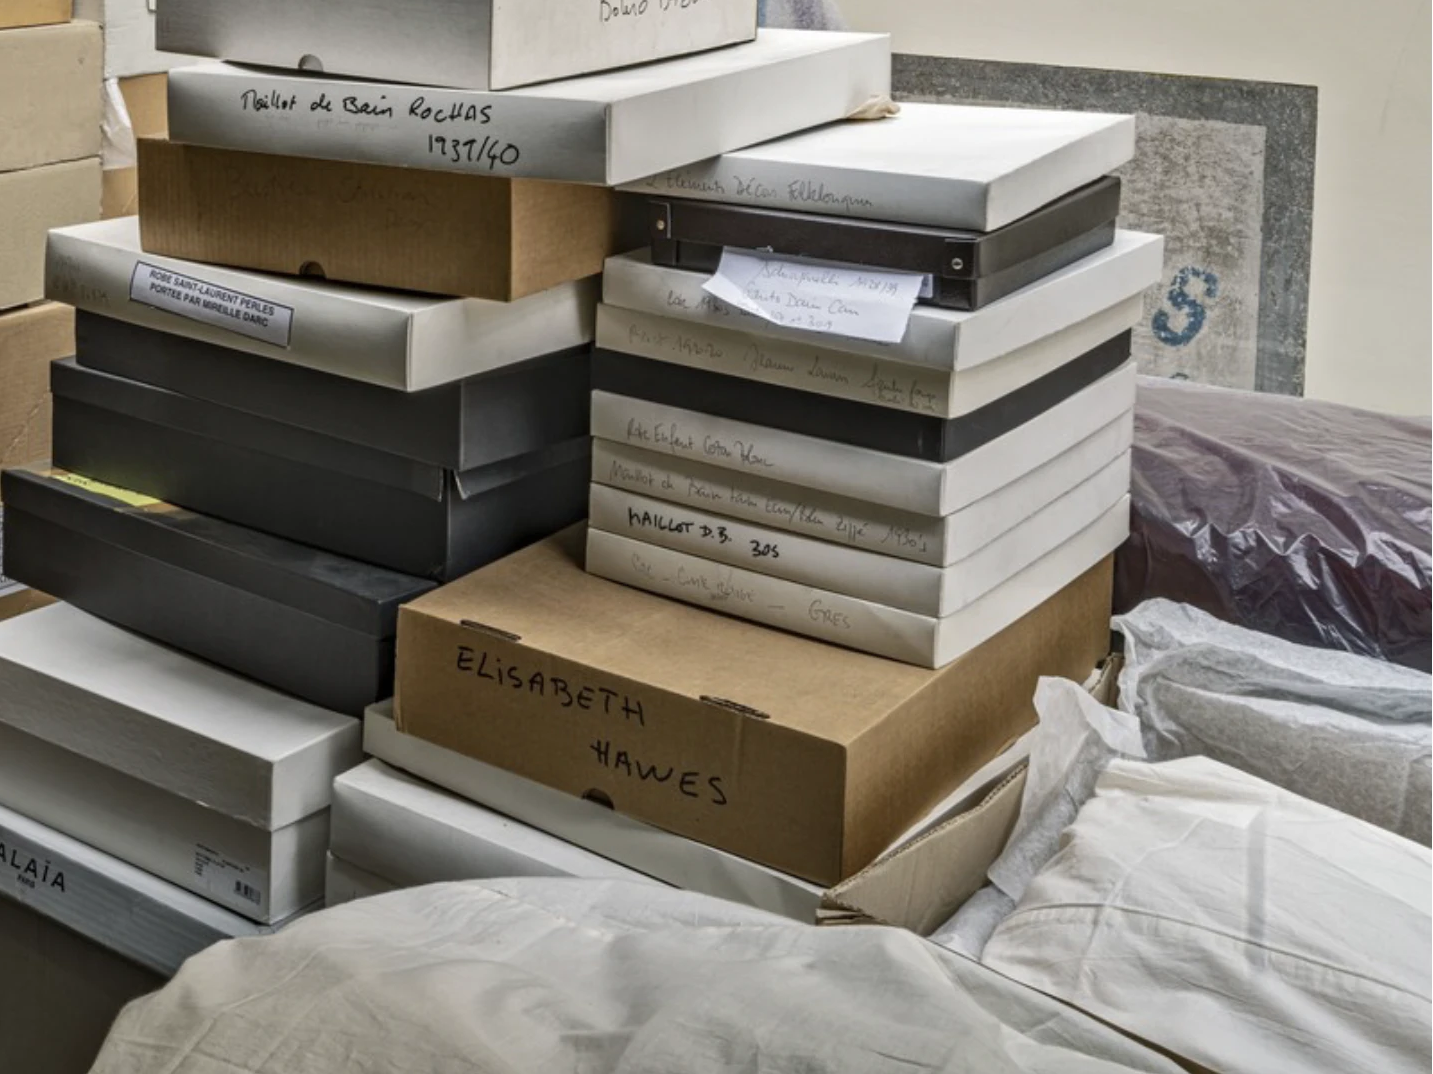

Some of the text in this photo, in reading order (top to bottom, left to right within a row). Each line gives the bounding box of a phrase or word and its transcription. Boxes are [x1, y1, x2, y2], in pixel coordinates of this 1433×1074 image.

[310, 92, 332, 113] de
[342, 94, 394, 119] Bain
[148, 268, 276, 317] ROBE SAINT-LAURENT PERLES
[183, 292, 202, 307] PAR
[201, 300, 242, 321] MIREILLE
[242, 311, 269, 328] DARC
[455, 644, 646, 728] ELISABETH
[589, 738, 728, 807] HAWES
